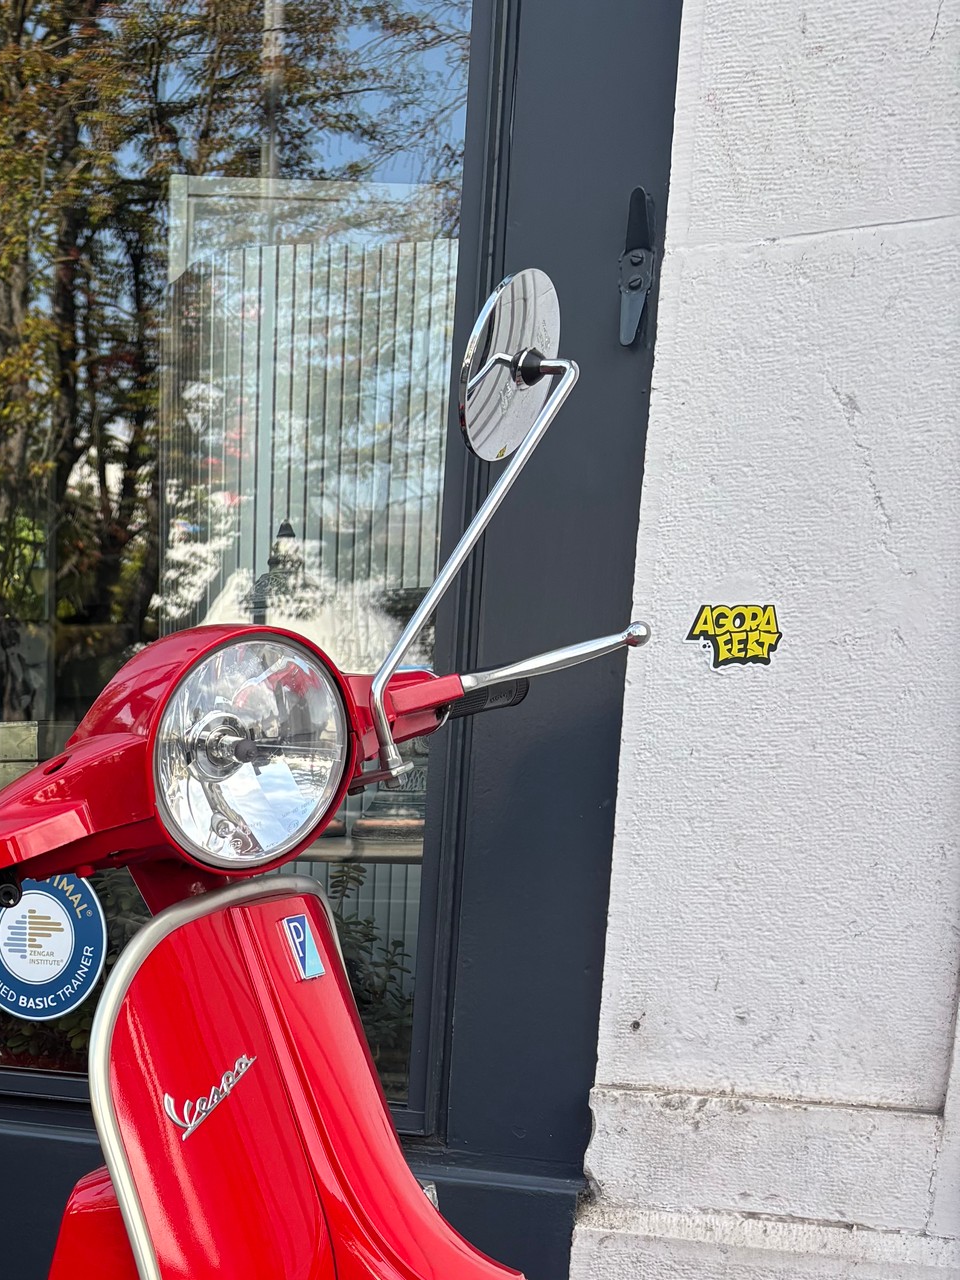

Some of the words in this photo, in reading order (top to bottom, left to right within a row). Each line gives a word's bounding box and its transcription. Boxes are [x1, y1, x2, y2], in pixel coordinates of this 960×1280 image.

[690, 605, 779, 636] AGORA
[715, 630, 781, 663] FEST
[28, 950, 55, 958] ZENGAR
[18, 995, 57, 1009] BASIC
[56, 945, 95, 1001] TRAINER
[163, 1053, 258, 1141] Vespa
